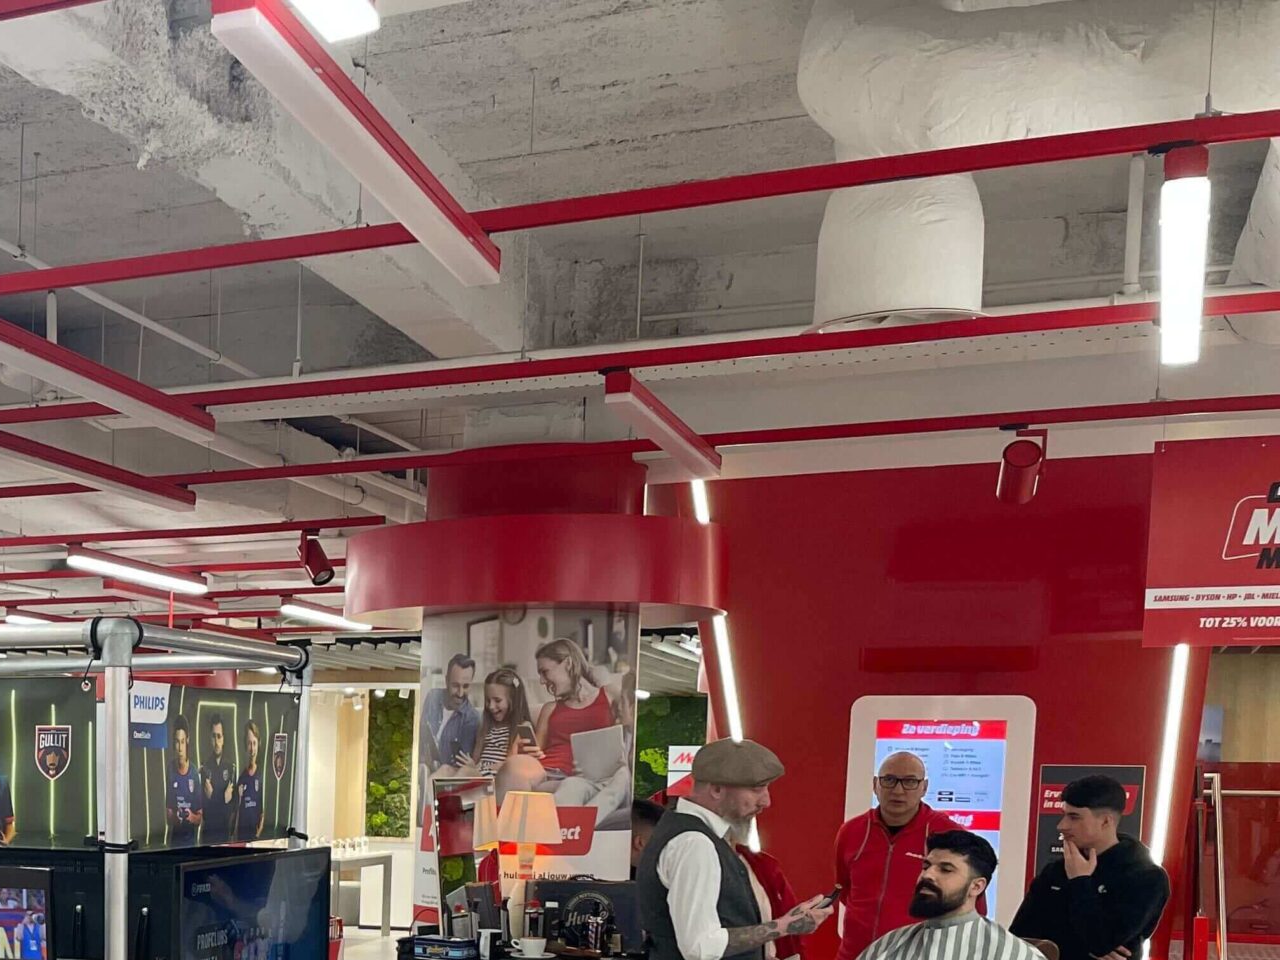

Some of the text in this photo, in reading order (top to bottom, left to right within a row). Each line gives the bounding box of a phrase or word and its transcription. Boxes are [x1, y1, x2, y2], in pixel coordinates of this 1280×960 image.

[1261, 592, 1280, 600] MIEL
[1199, 617, 1222, 628] TOT
[1222, 616, 1247, 628] 25%
[133, 695, 165, 711] PHILIPS
[39, 734, 68, 749] GULLIT
